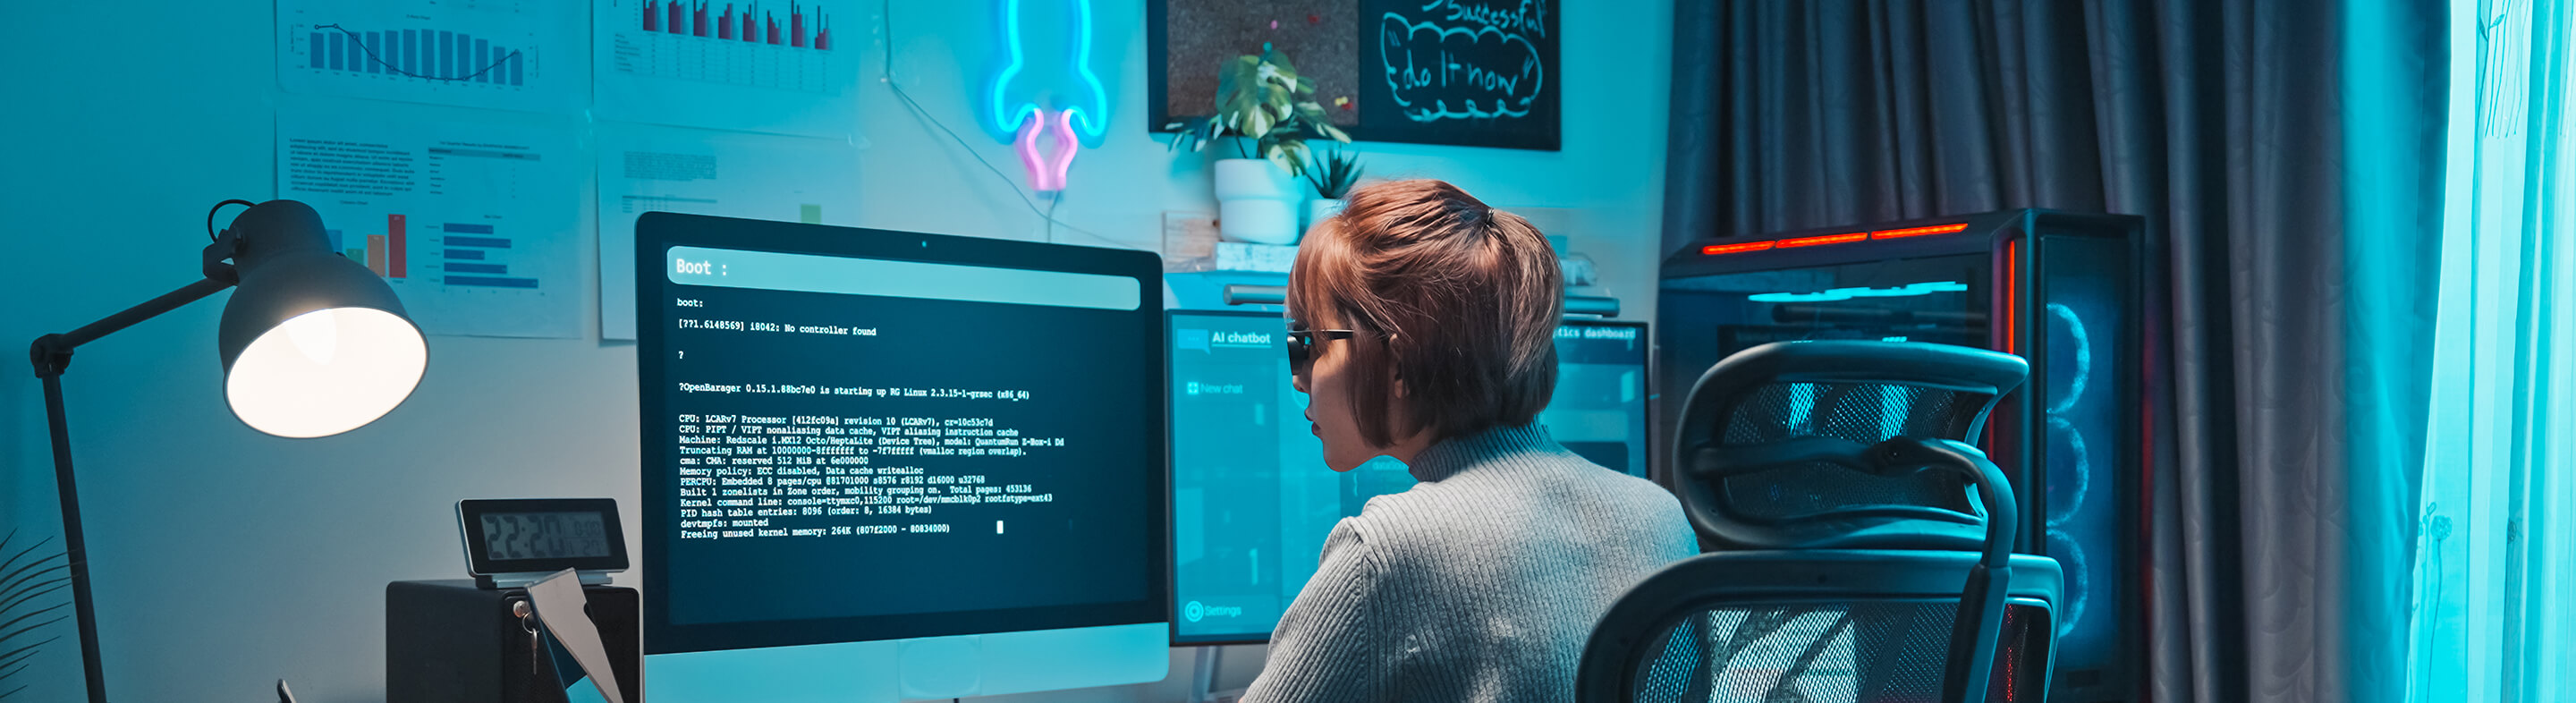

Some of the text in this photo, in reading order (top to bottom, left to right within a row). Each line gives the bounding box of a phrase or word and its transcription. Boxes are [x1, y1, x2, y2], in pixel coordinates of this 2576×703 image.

[1403, 48, 1432, 90] do
[1467, 62, 1520, 97] now
[676, 258, 712, 275] Boot
[676, 297, 703, 308] boot:
[750, 321, 780, 332] i8042:
[784, 323, 796, 333] No
[799, 325, 849, 335] controller
[852, 326, 877, 336] found
[1212, 331, 1271, 344] AI chatbot
[678, 382, 741, 394] ?OpenBarager
[819, 385, 830, 394] is
[834, 386, 873, 397] starting
[876, 388, 887, 398] up
[889, 387, 901, 396] RG
[903, 387, 928, 397] Linux
[1200, 384, 1243, 394] New chat
[678, 413, 700, 423] CPU:
[705, 414, 737, 424] LCARv7
[741, 415, 787, 424] Processor
[843, 416, 883, 426] revision
[886, 416, 896, 426] 10
[678, 424, 700, 435] CPU:
[705, 425, 727, 434] PIPT
[739, 425, 763, 435] VIPT
[766, 425, 822, 437] nonaliasing
[825, 426, 845, 436] data
[848, 426, 877, 437] cache,
[880, 427, 902, 436] VIPT
[903, 427, 942, 438] aliasing
[945, 428, 994, 437] instruction
[996, 428, 1019, 437] cache
[678, 435, 721, 445] Machine:
[725, 435, 767, 445] Redscale
[805, 436, 874, 448] Octo/HeptaLite
[877, 436, 911, 448] (Device
[912, 436, 940, 448] Tree),
[944, 436, 971, 446] model:
[679, 445, 733, 457] Truncating
[736, 445, 753, 455] RAM
[756, 446, 768, 455] at
[858, 446, 869, 455] to
[919, 446, 955, 456] (vmalloc
[958, 446, 986, 457] region
[679, 457, 700, 465] cma:
[705, 456, 726, 465] CMA:
[732, 456, 774, 466] reserved
[776, 455, 792, 465] 512
[795, 456, 813, 465] MiB
[815, 456, 826, 465] at
[679, 465, 924, 478] Memory policy: ECC disabled, Data cache writealloc
[680, 476, 716, 486] PERCPU:
[721, 476, 764, 486] Embedded
[767, 476, 774, 486] 8
[776, 476, 822, 487] pages/cpu
[872, 475, 897, 485] s8576
[900, 475, 924, 485] r8192
[927, 475, 955, 485] d16000
[958, 475, 986, 485] u32768
[680, 487, 708, 496] Built
[722, 487, 768, 496] zonelists
[772, 487, 784, 495] in
[786, 486, 808, 495] Zone
[810, 486, 840, 496] order,
[843, 486, 884, 497] mobility
[886, 485, 925, 497] grouping
[926, 487, 942, 495] on.
[949, 485, 972, 495] Total
[975, 486, 1002, 495] pages:
[680, 497, 713, 507] Kernel
[716, 497, 754, 507] command
[758, 496, 783, 506] line:
[680, 504, 932, 518] PID hash table entries: 8096 (order: 8, 16384 bytes)
[680, 517, 769, 529] devtmpfs: mounted
[681, 529, 718, 540] Freeing
[722, 528, 754, 538] unused
[758, 527, 789, 537] kernel
[792, 528, 826, 538] memory:
[831, 526, 852, 536] 264K
[856, 524, 898, 536] (807f2000
[910, 523, 950, 533] 80834000)
[1205, 605, 1242, 618] Settings
